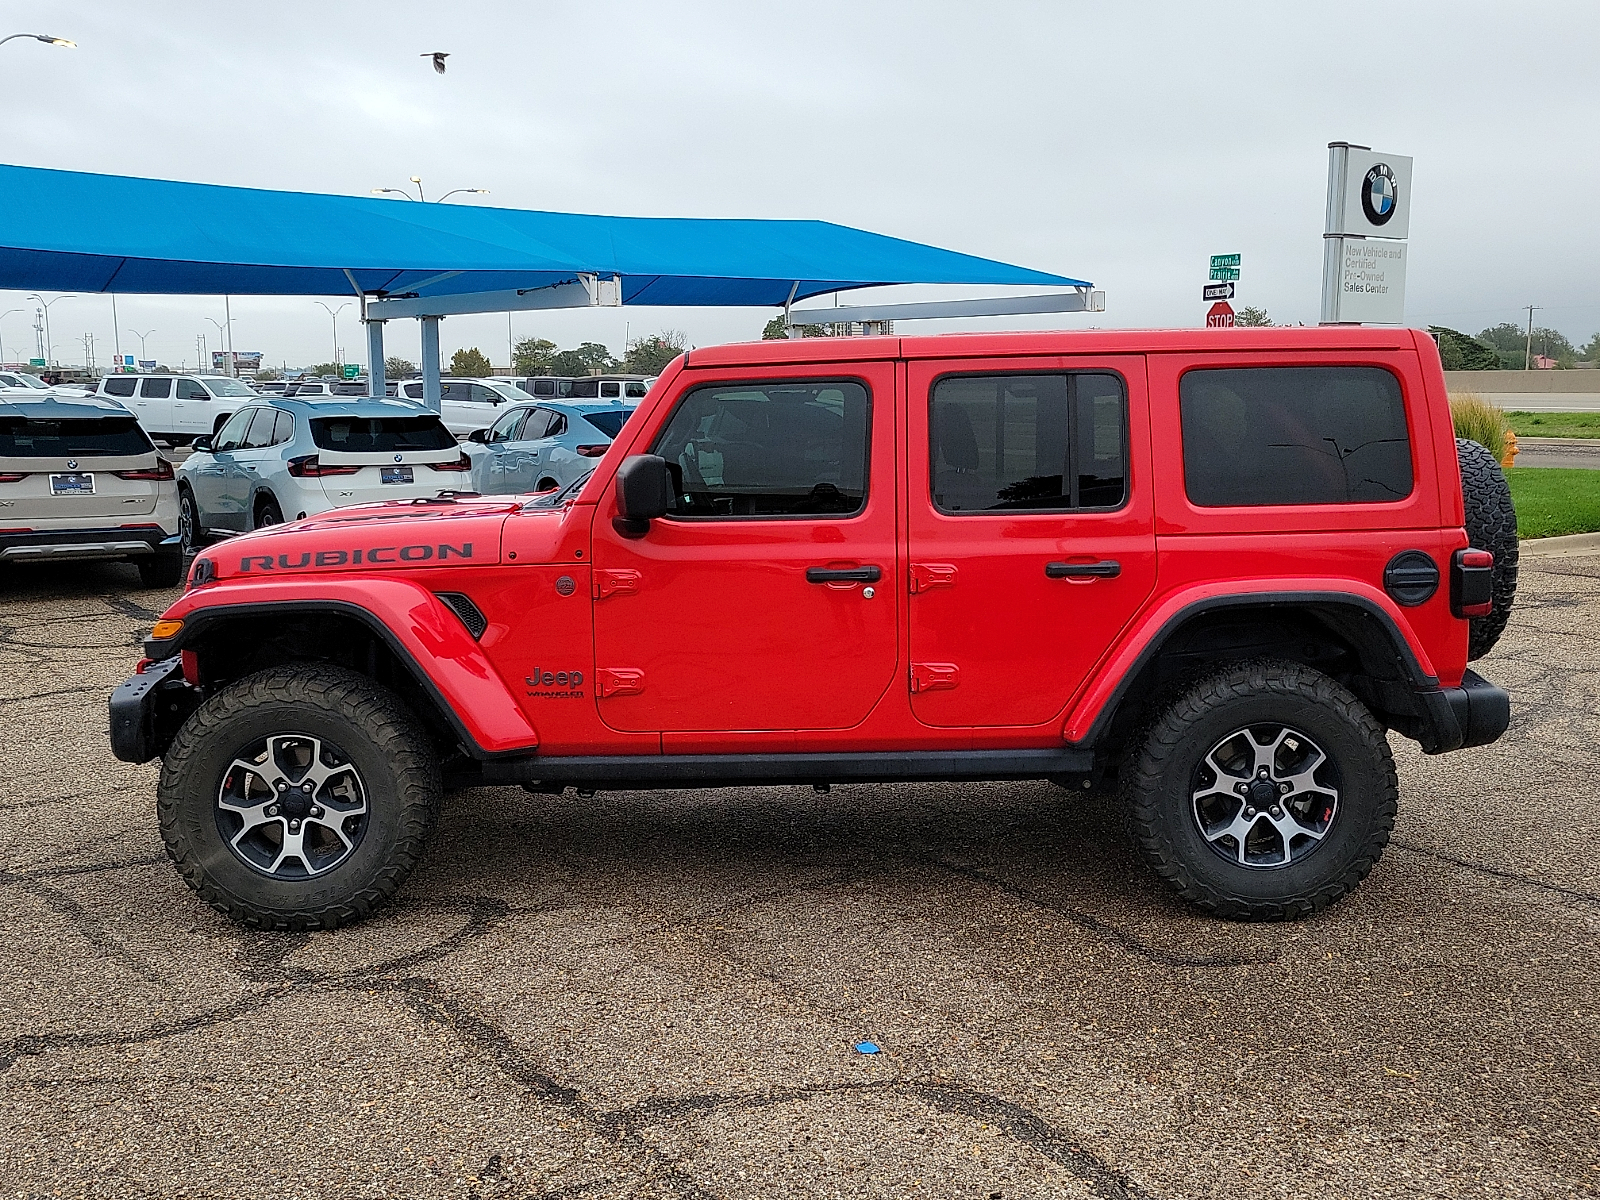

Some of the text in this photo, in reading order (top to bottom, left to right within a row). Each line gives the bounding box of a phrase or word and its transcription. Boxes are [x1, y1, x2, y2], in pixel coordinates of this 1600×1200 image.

[1368, 165, 1397, 188] BMW
[1345, 245, 1402, 259] New Vehicle and
[1210, 256, 1232, 267] Canyon
[1345, 257, 1376, 269] Certified
[1210, 269, 1231, 280] Prairie
[1344, 270, 1385, 282] Pre-Owned
[1206, 289, 1218, 297] ONE
[1344, 281, 1389, 294] Sales Center
[1208, 313, 1233, 328] STOP
[240, 542, 473, 572] RUBICON
[525, 666, 583, 689] Jeep
